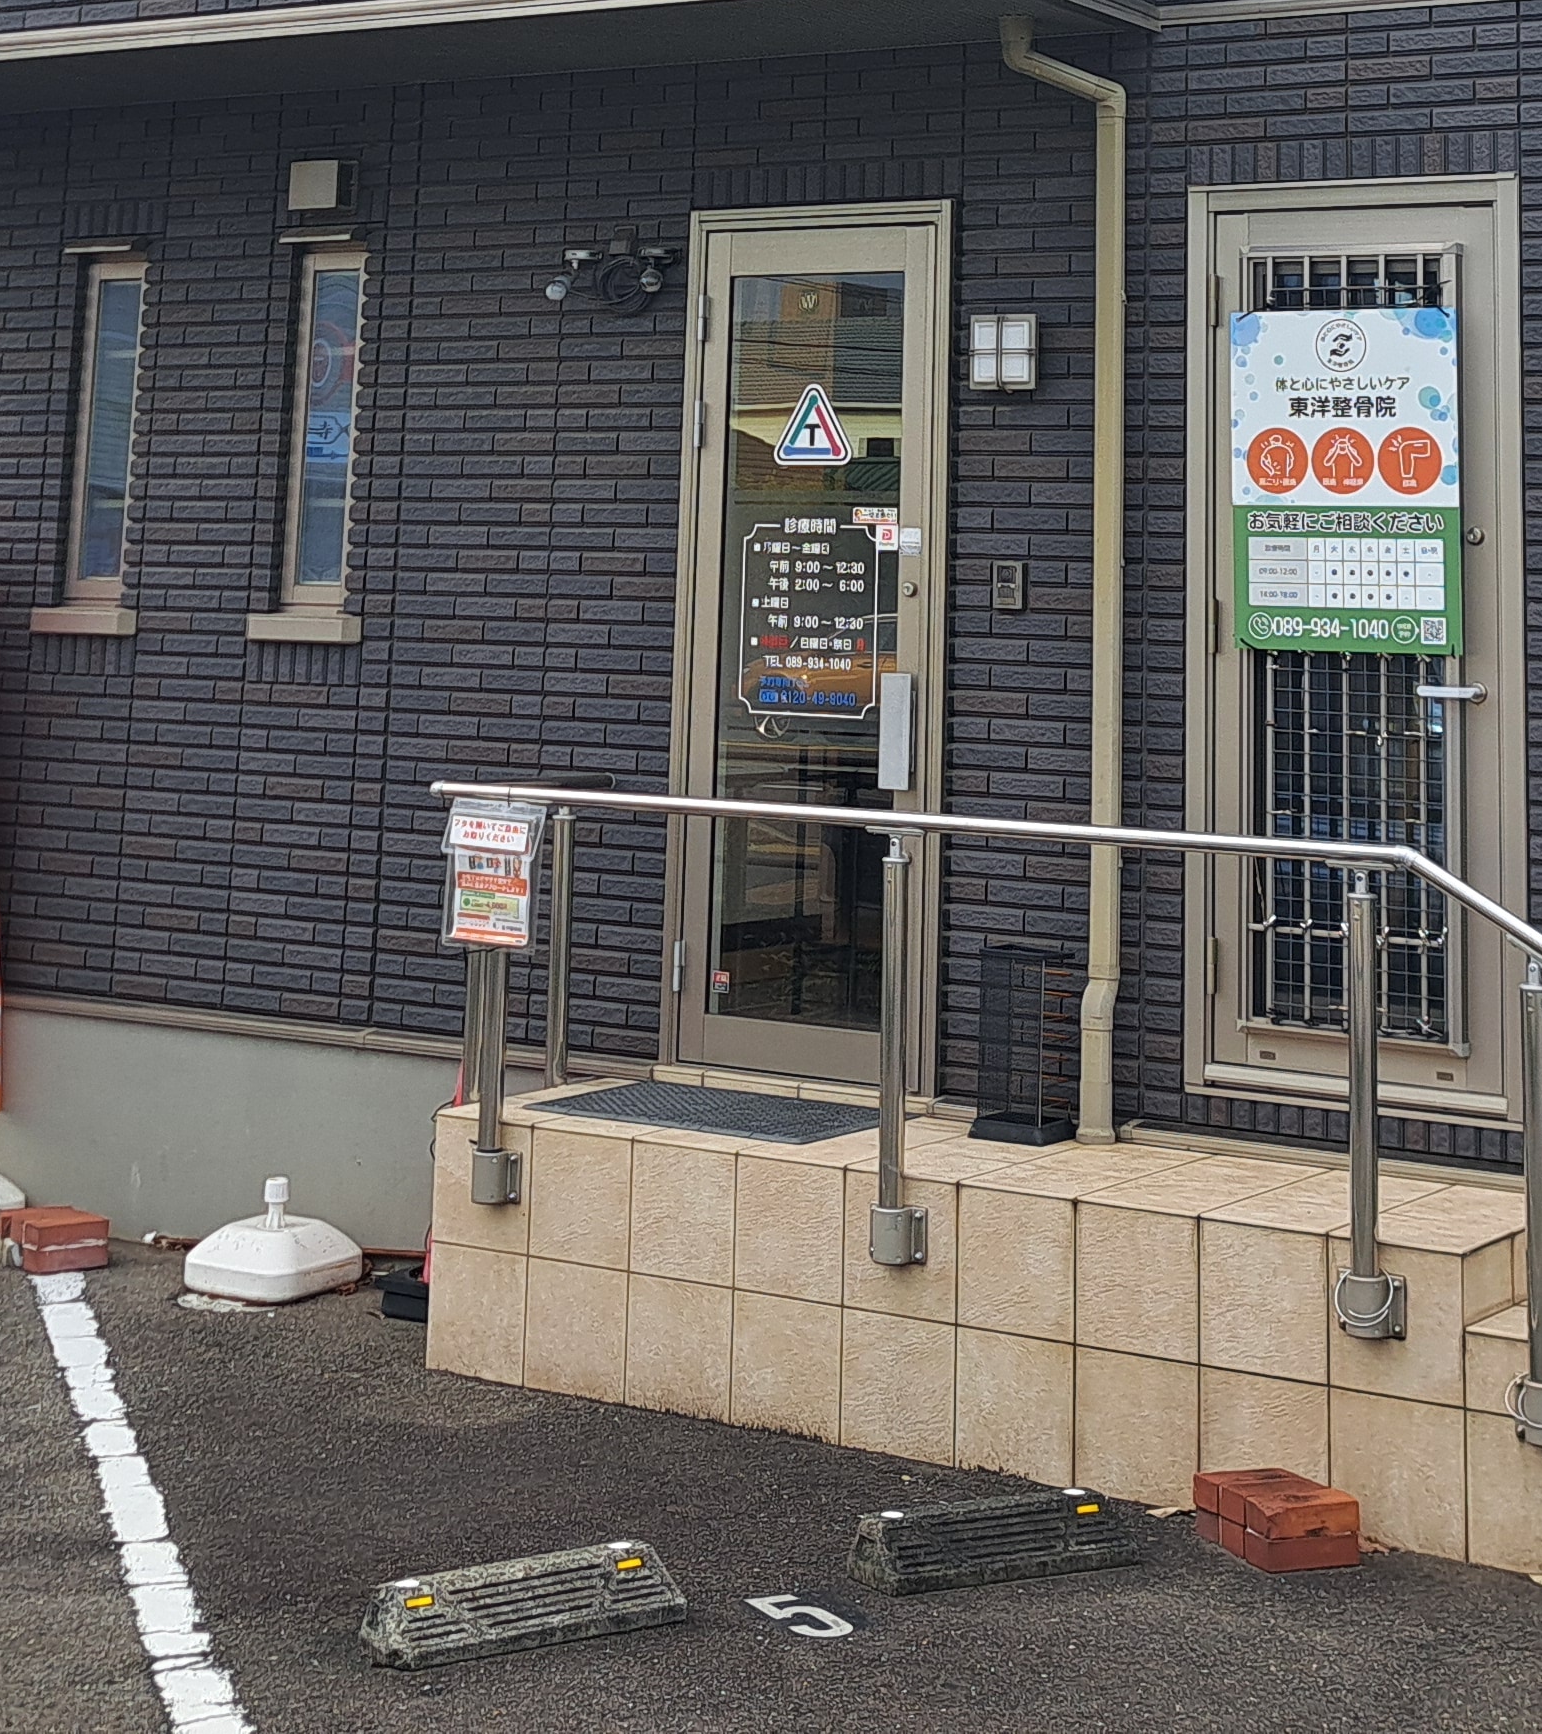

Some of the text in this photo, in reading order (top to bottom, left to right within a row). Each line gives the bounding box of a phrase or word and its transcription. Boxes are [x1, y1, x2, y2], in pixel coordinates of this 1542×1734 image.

[1275, 376, 1410, 392] 体と心にやさしいケア
[1288, 396, 1397, 418] 東洋整骨院
[804, 423, 821, 447] T
[785, 517, 837, 535] 診療時間
[1248, 512, 1444, 533] お気軽にご相談ください
[1312, 545, 1320, 553] 月
[1348, 545, 1357, 553] 水
[769, 560, 790, 574] 午前
[767, 577, 789, 591] 午後
[760, 596, 789, 609] 土曜日
[767, 613, 788, 629] 午前
[1273, 616, 1389, 640] 089-934-1040
[762, 655, 852, 671] TEL 089-934-1040
[742, 1593, 854, 1638] 5
